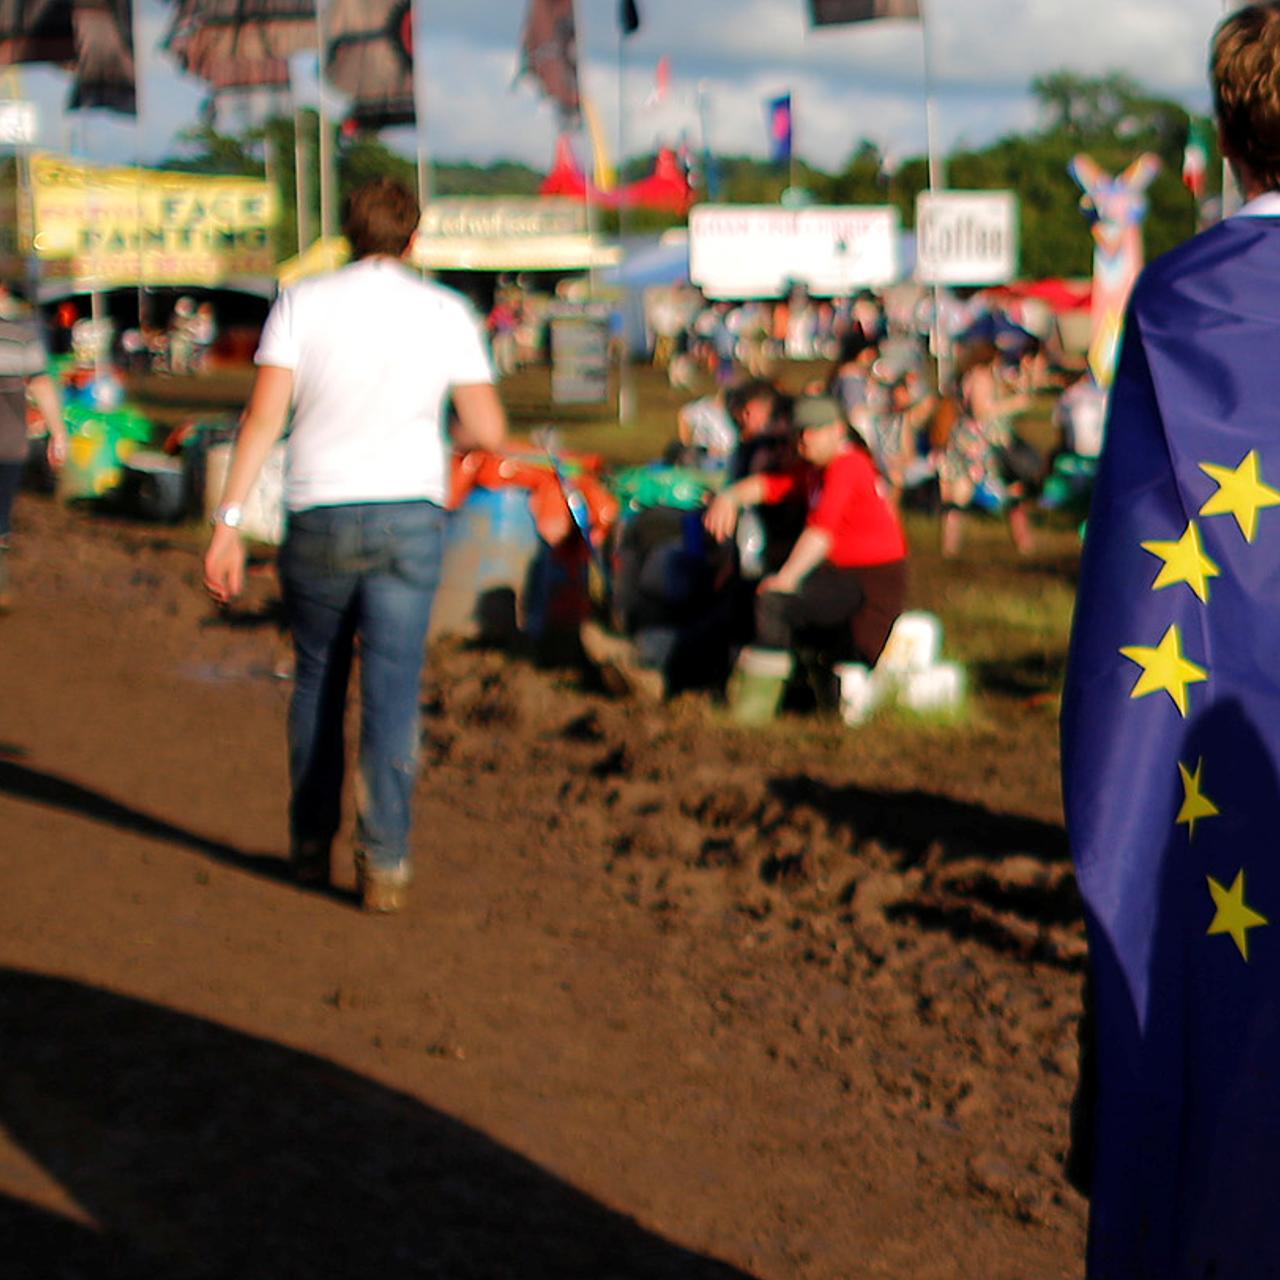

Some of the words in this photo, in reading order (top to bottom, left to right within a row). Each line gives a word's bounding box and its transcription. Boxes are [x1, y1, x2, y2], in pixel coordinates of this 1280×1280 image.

[162, 197, 263, 220] FACE
[80, 226, 269, 249] PAINTING
[919, 210, 1005, 260] Coffee
